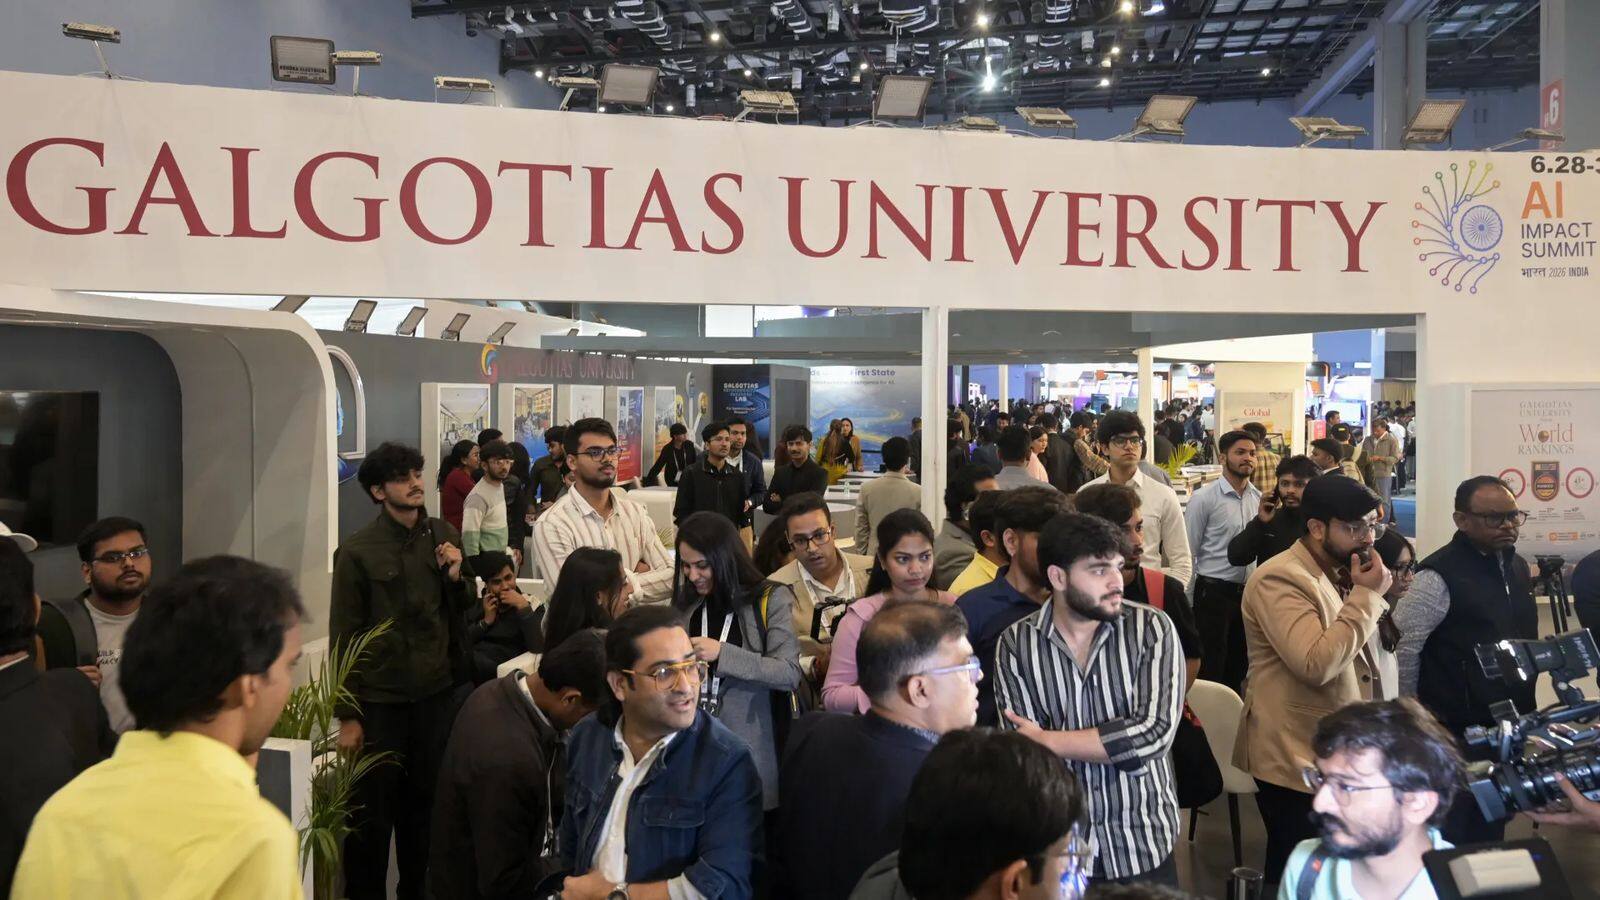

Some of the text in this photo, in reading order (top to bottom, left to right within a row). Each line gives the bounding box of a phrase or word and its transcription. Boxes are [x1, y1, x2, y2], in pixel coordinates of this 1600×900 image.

[6, 137, 1388, 272] GALGOTIAS UNIVERSITY
[1521, 181, 1563, 219] AI
[1521, 222, 1592, 239] IMPACT
[1521, 241, 1597, 258] SUMMIT
[1521, 267, 1589, 278] भारत 2026 INDIA
[871, 368, 896, 376] State
[1520, 400, 1573, 409] GALGOTIAS
[1243, 406, 1271, 417] Global
[1519, 409, 1572, 417] UNIVERSITY
[1519, 423, 1573, 443] World
[1518, 444, 1575, 456] RANKINGS
